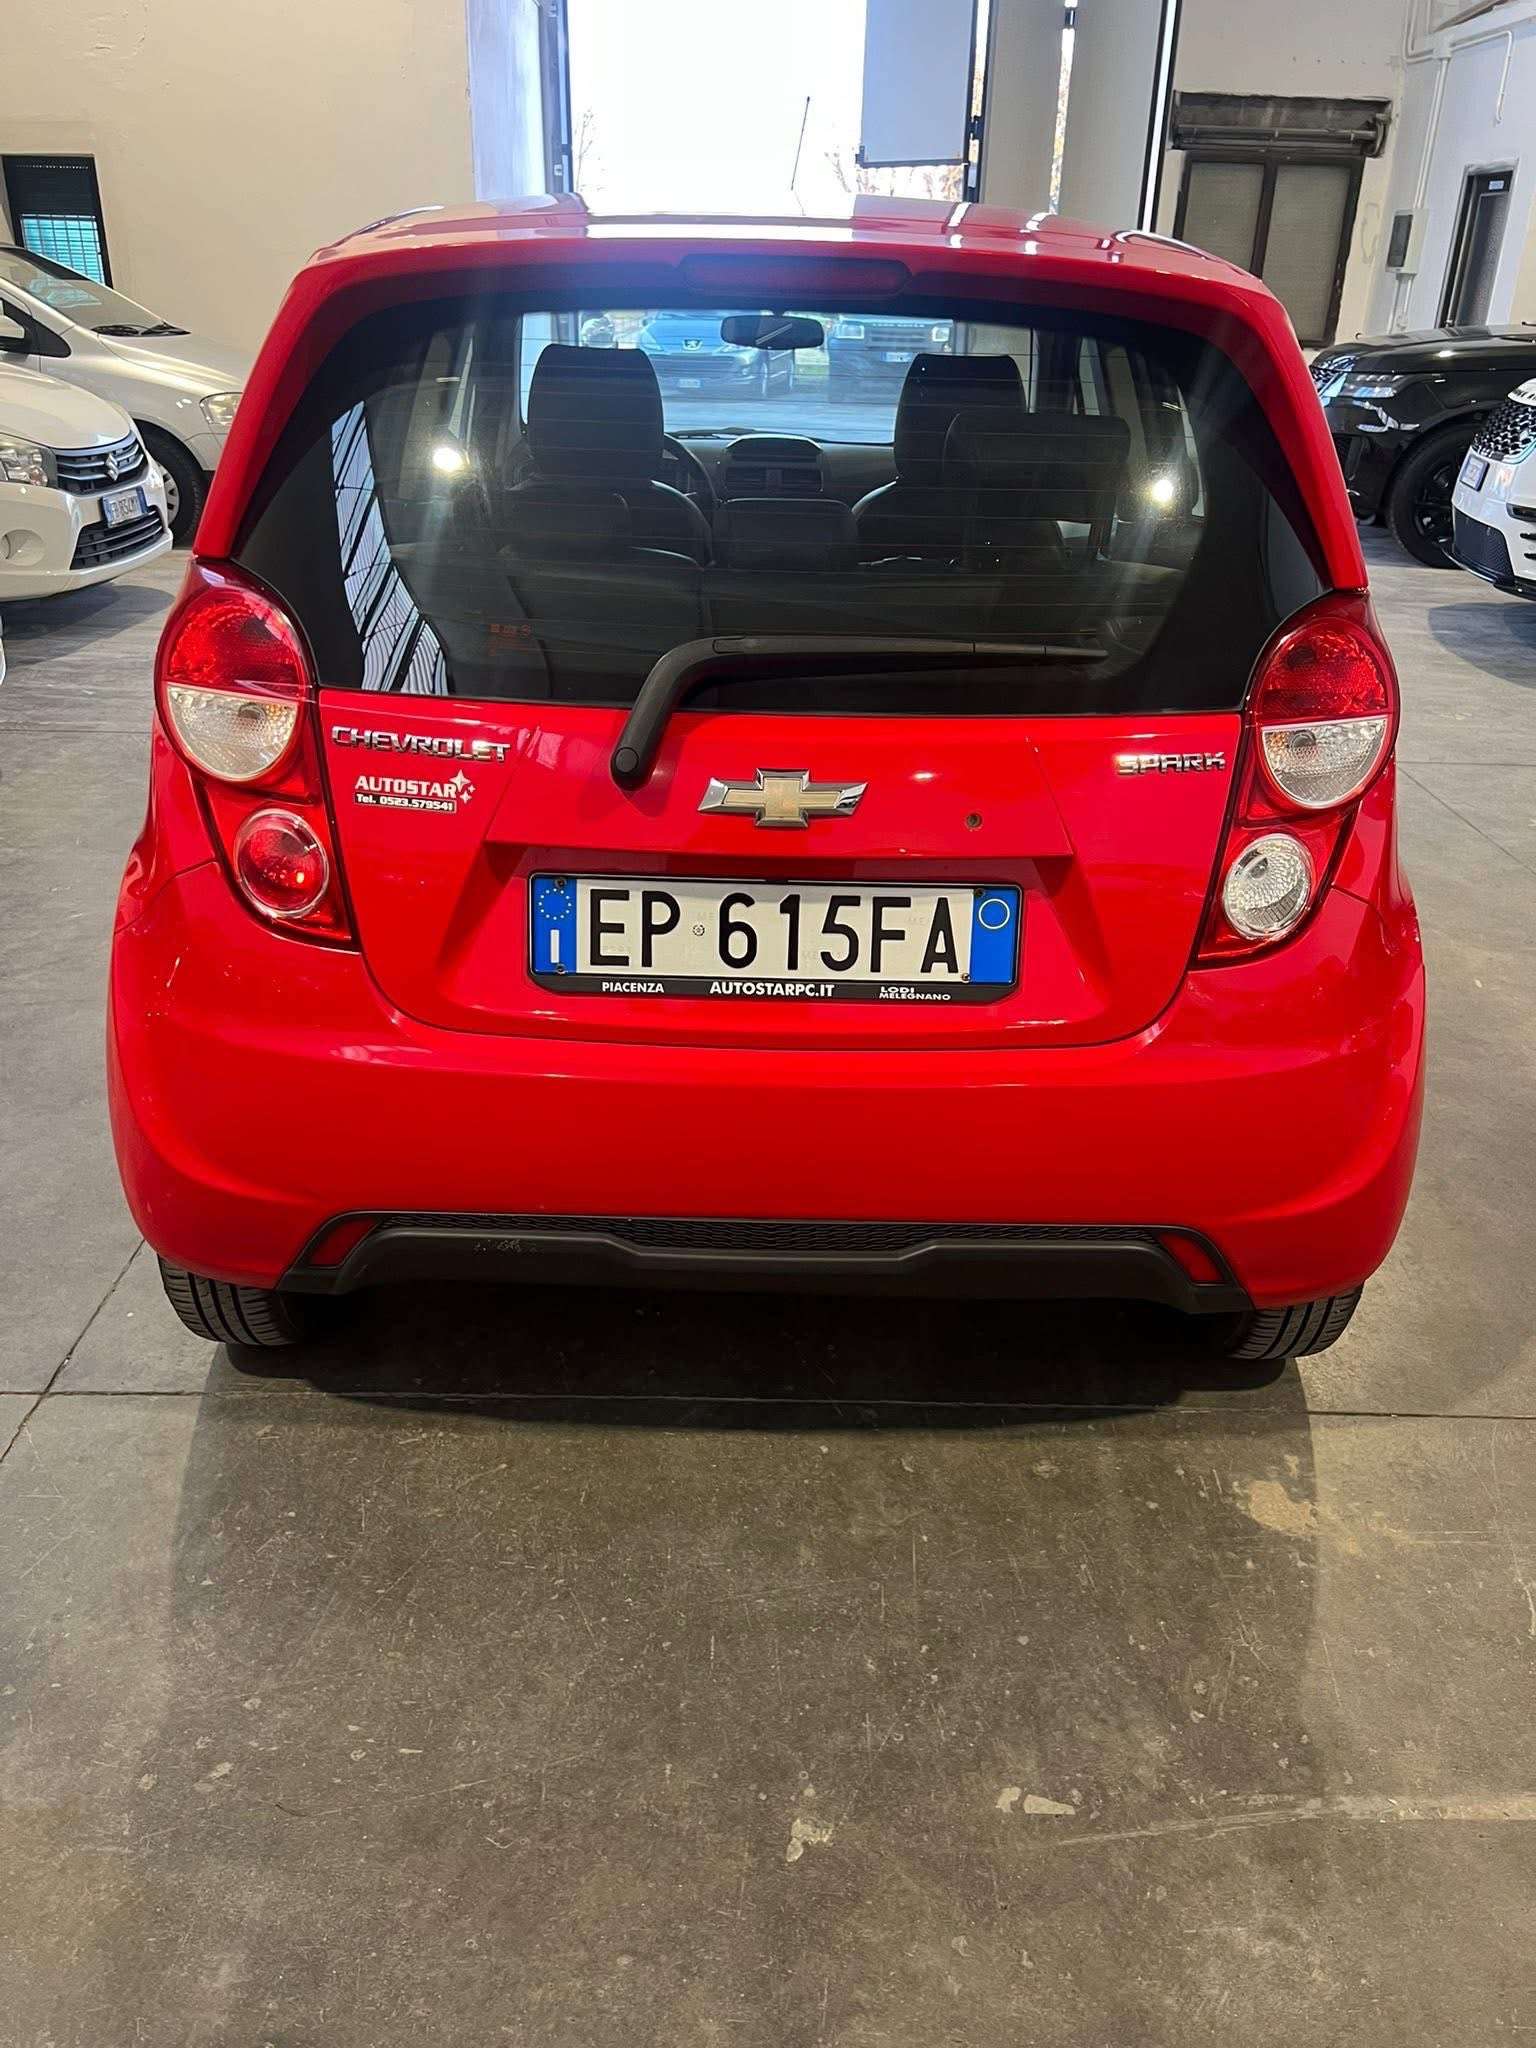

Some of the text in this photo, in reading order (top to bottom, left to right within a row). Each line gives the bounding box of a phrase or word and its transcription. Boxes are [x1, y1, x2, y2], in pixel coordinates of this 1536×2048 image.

[332, 725, 510, 762] CHEVROLET
[1117, 752, 1226, 774] SPARK
[354, 775, 457, 799] AUTOSTAR
[356, 793, 377, 804] Tel.
[590, 889, 959, 975] EP 615FA
[602, 981, 834, 997] PIACENZA AUTOSTARPC.IT
[879, 993, 951, 1001] MELEGNANO
